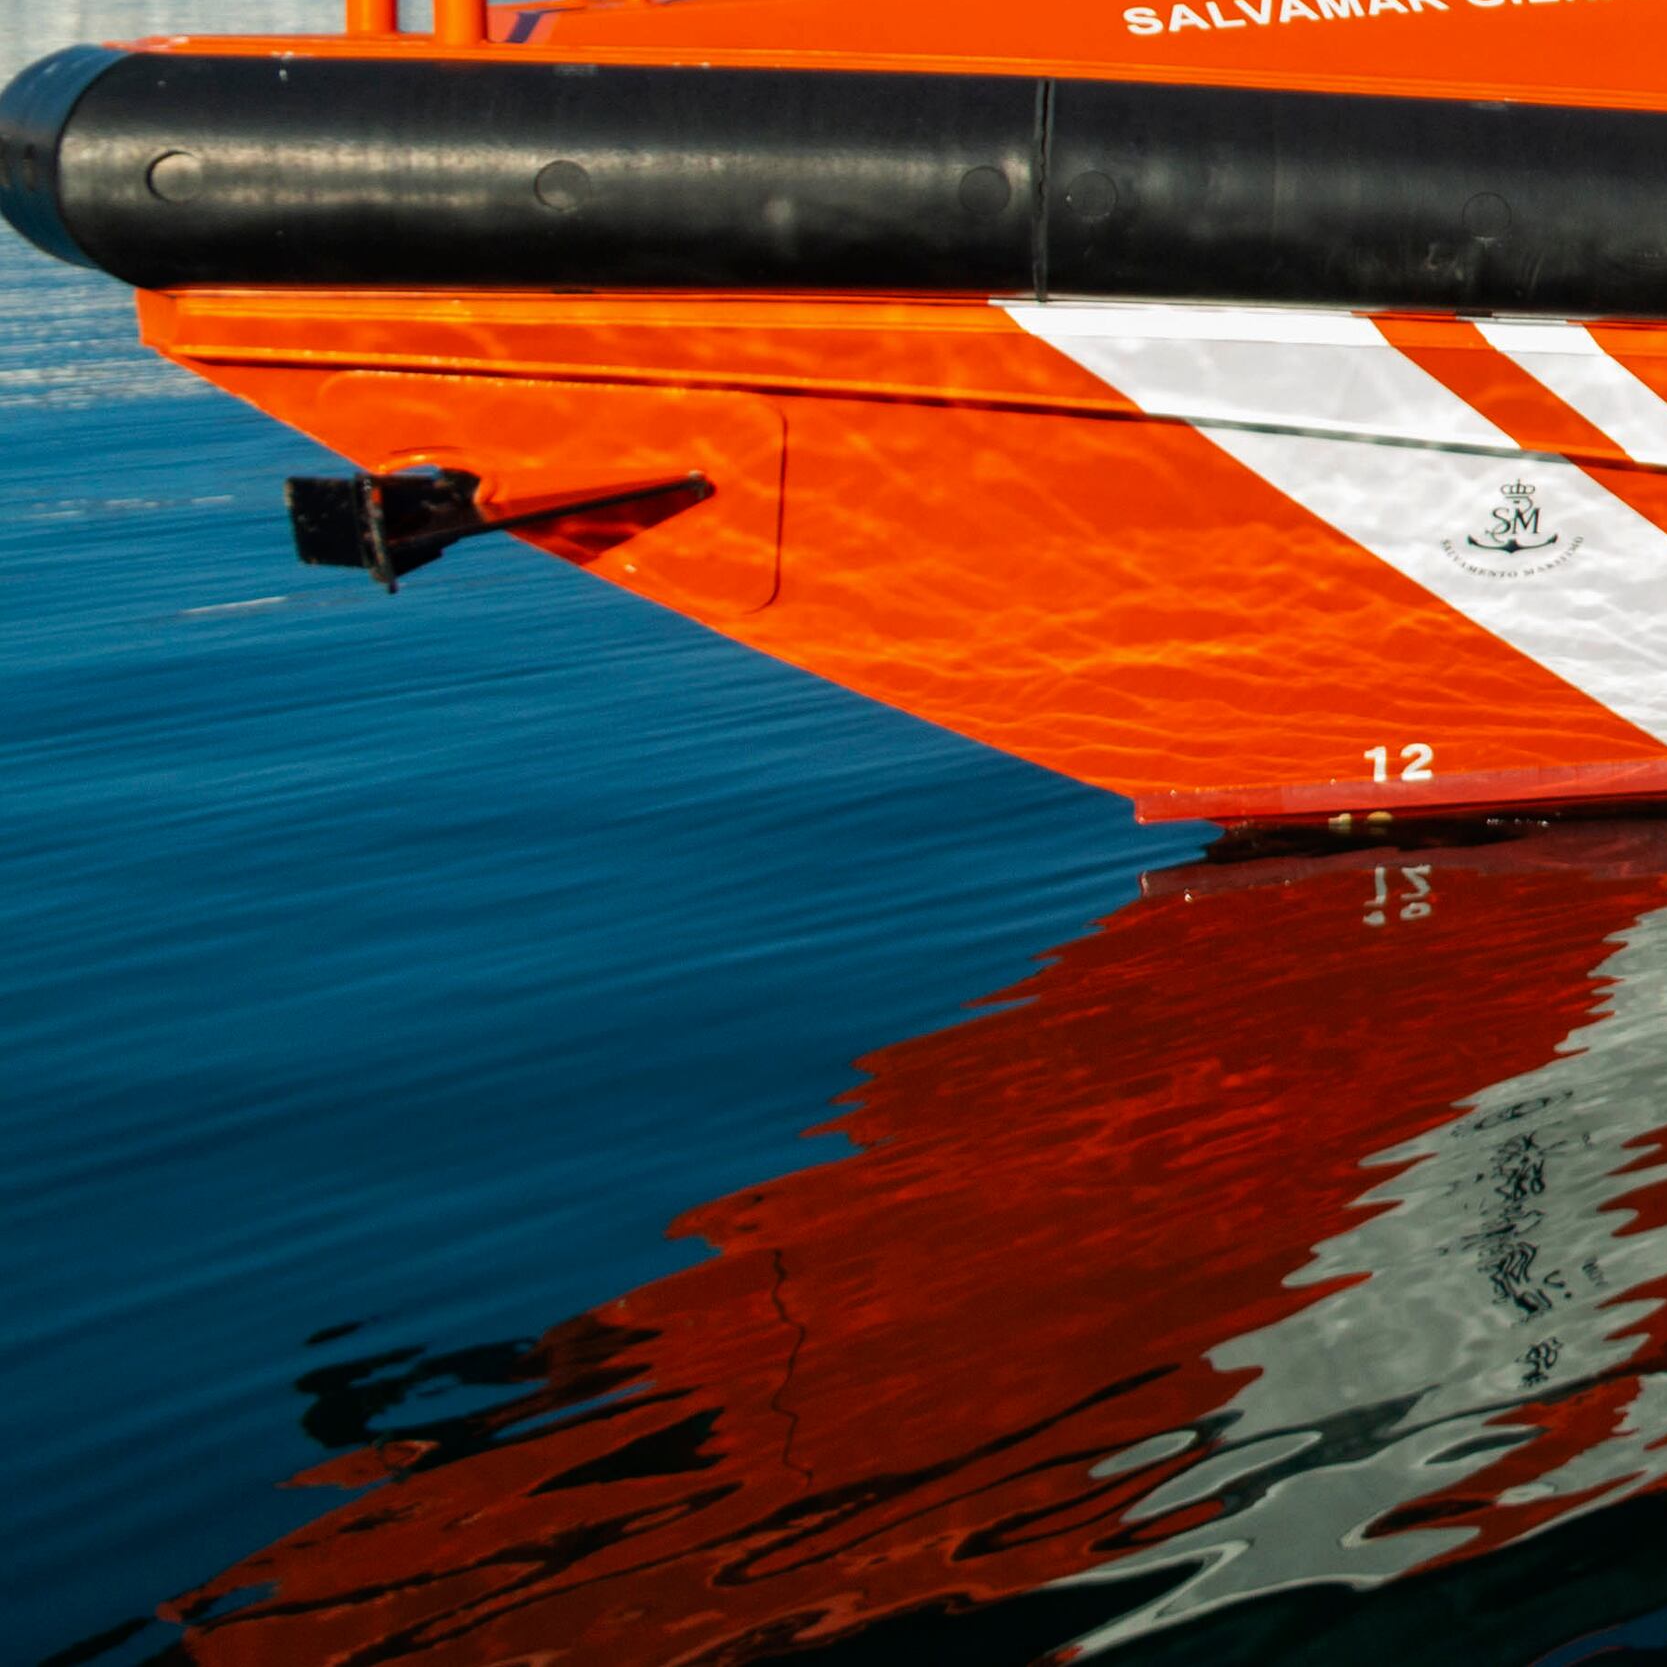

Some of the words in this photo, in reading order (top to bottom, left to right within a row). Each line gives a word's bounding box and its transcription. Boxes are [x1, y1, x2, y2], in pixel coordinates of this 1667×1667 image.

[1491, 507, 1541, 535] SM
[1440, 537, 1519, 579] SALVAMENTO
[1523, 534, 1585, 578] MARITIMO
[1363, 743, 1434, 783] 12
